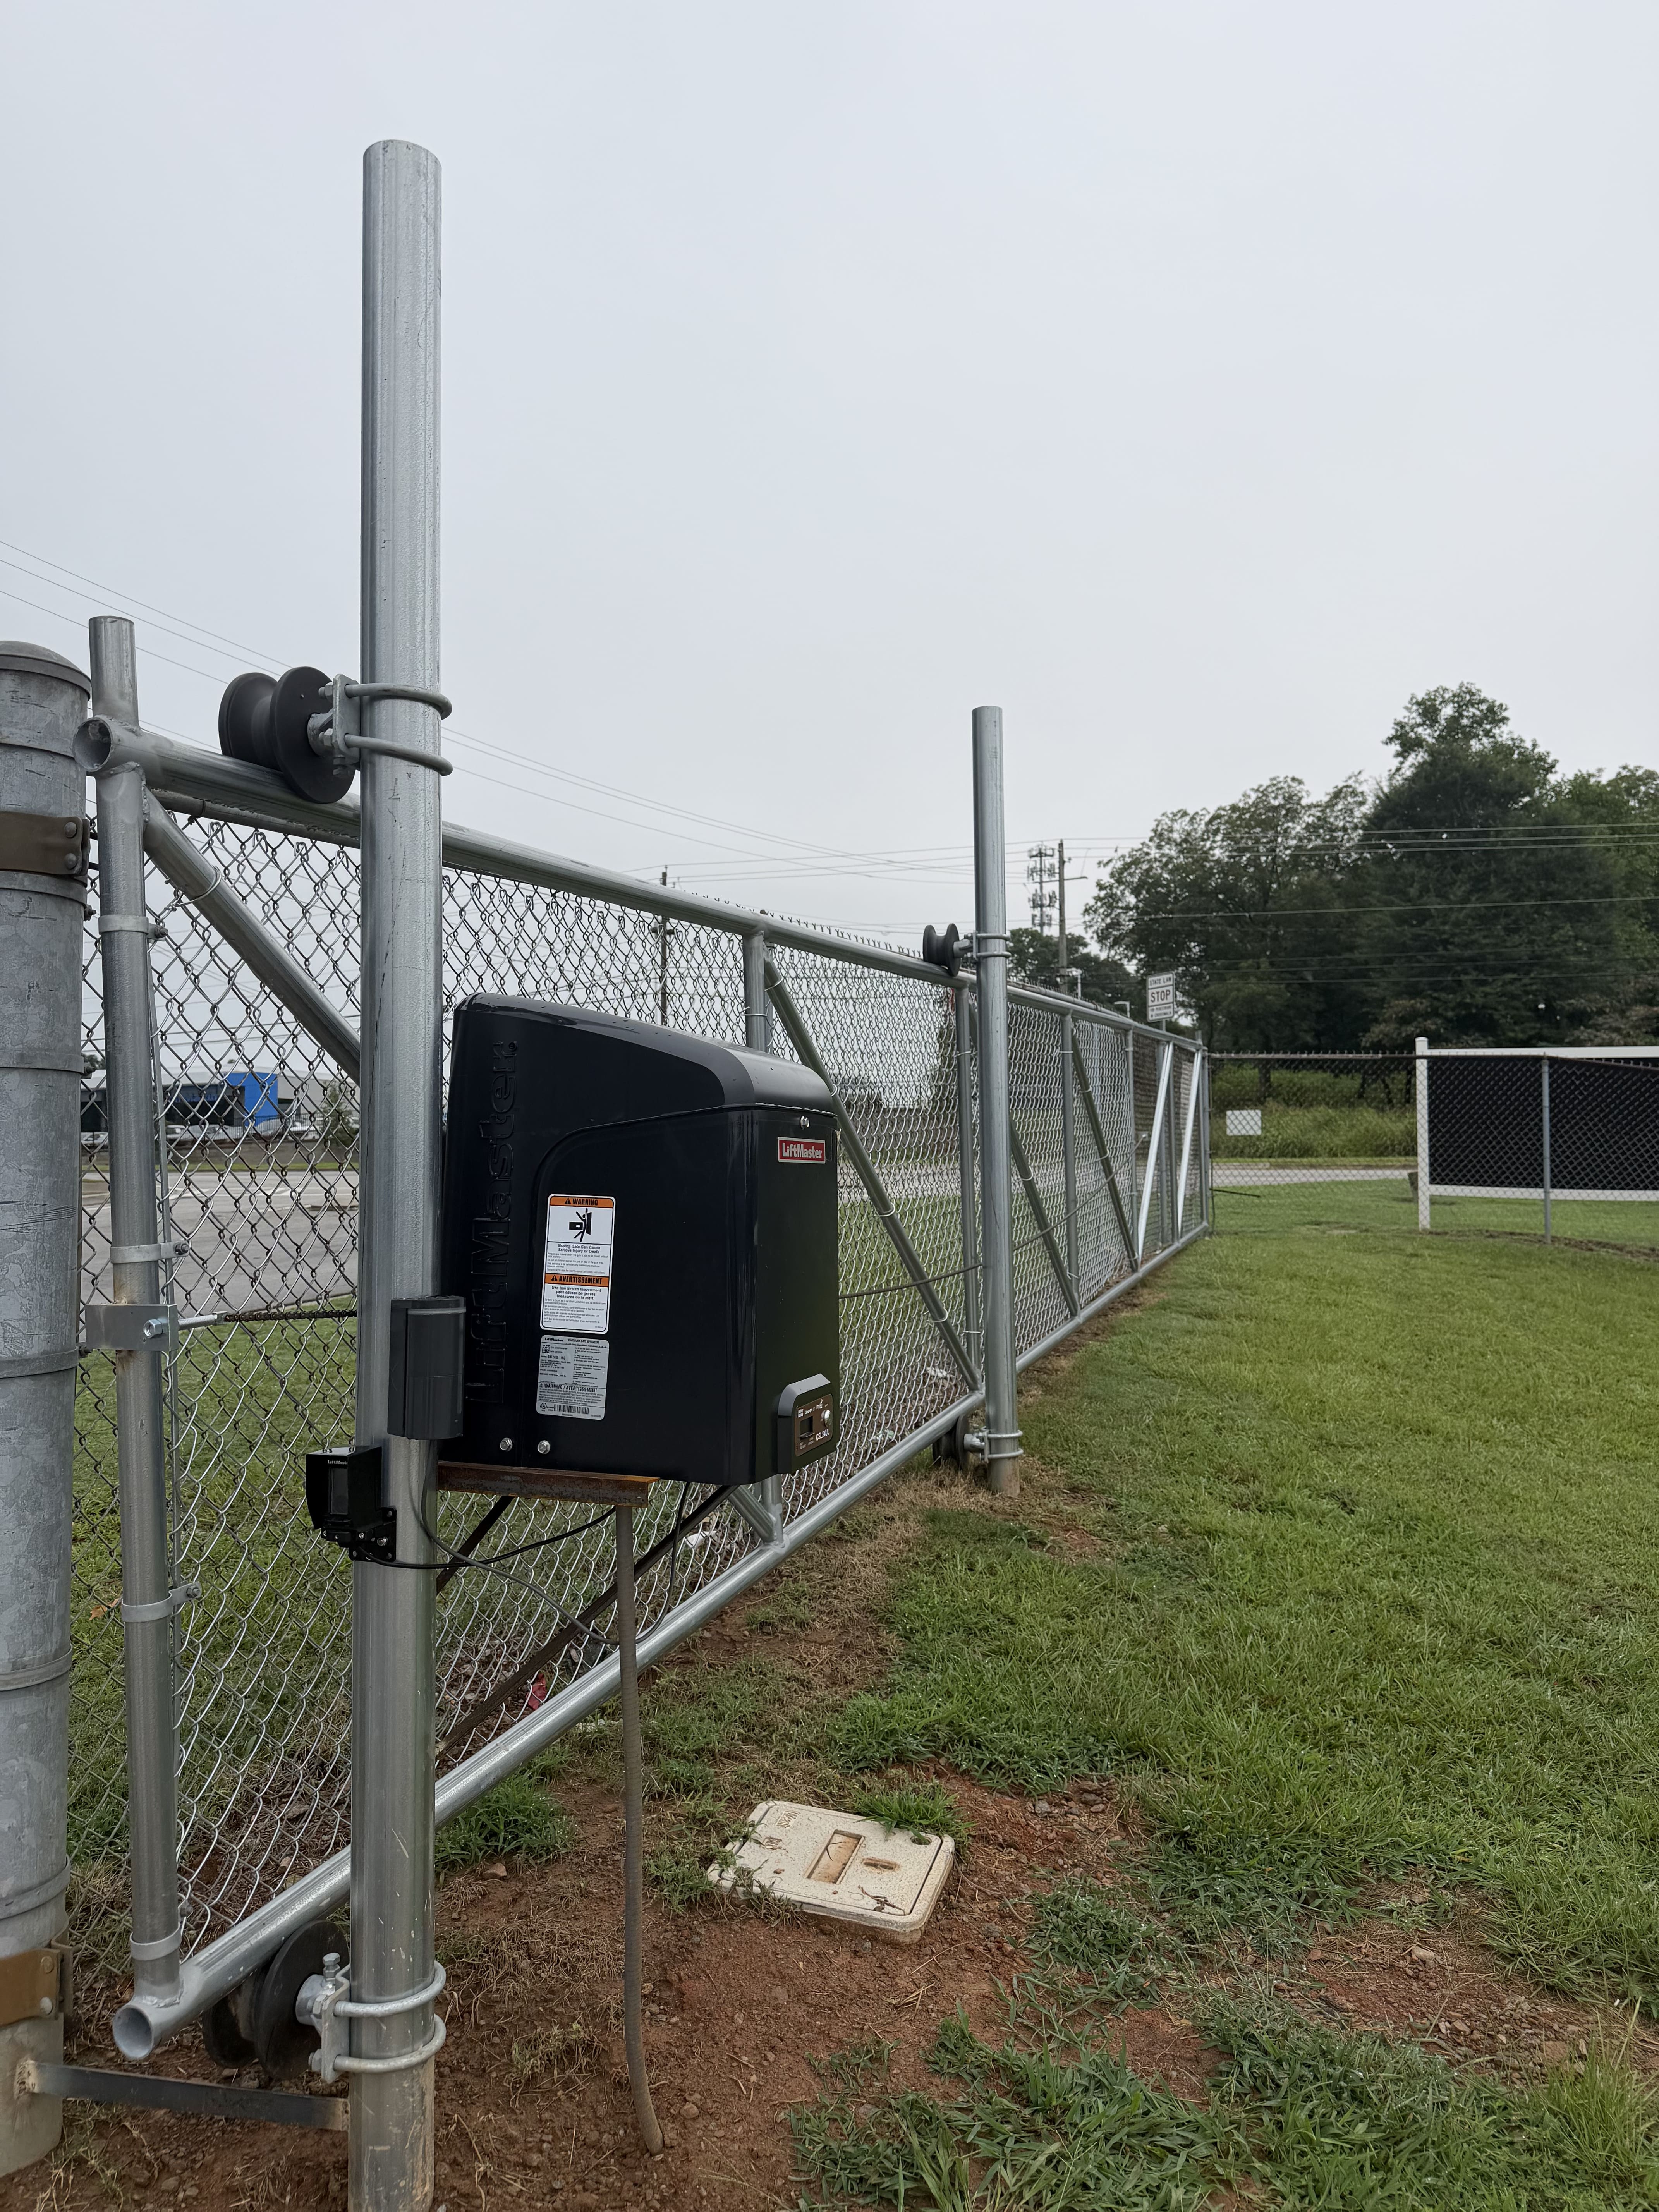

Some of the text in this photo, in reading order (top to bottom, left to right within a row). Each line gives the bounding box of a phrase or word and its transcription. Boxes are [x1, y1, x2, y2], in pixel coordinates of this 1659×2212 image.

[1151, 989, 1170, 1003] STOP
[782, 1143, 822, 1158] LiftMaster
[466, 1042, 517, 1405] LiftMaster
[559, 1276, 603, 1284] AVERTISSEMENT
